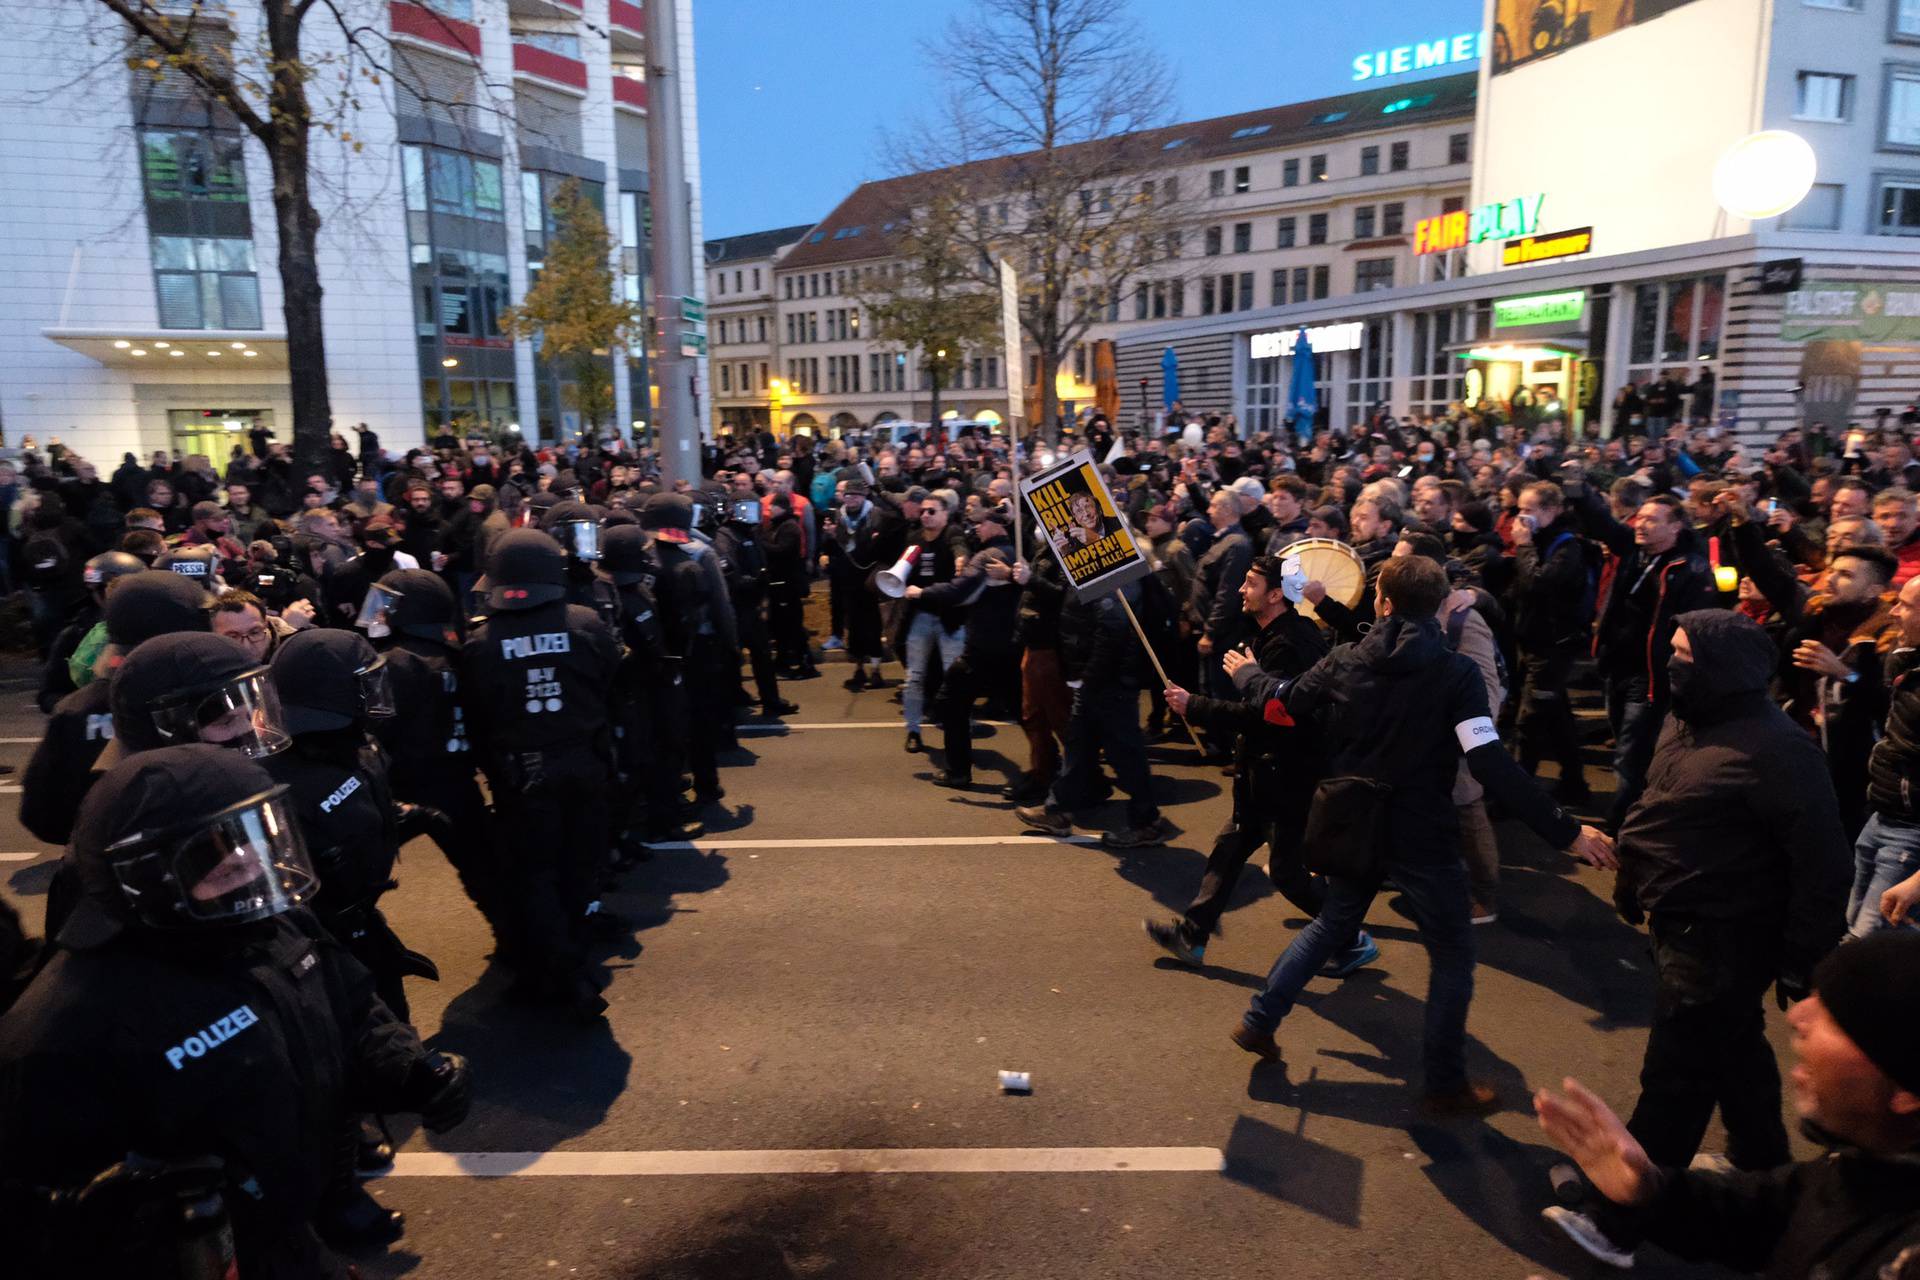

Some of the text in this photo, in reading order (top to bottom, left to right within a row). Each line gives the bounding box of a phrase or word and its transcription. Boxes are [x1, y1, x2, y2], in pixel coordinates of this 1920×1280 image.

[1030, 479, 1071, 512] KILL
[1063, 535, 1120, 571] IMPFEN!
[1071, 550, 1126, 581] JETZT! ALLE!
[501, 633, 570, 660] POLIZEI
[320, 776, 361, 813] POLIZEI
[165, 1004, 260, 1070] POLIZEI
